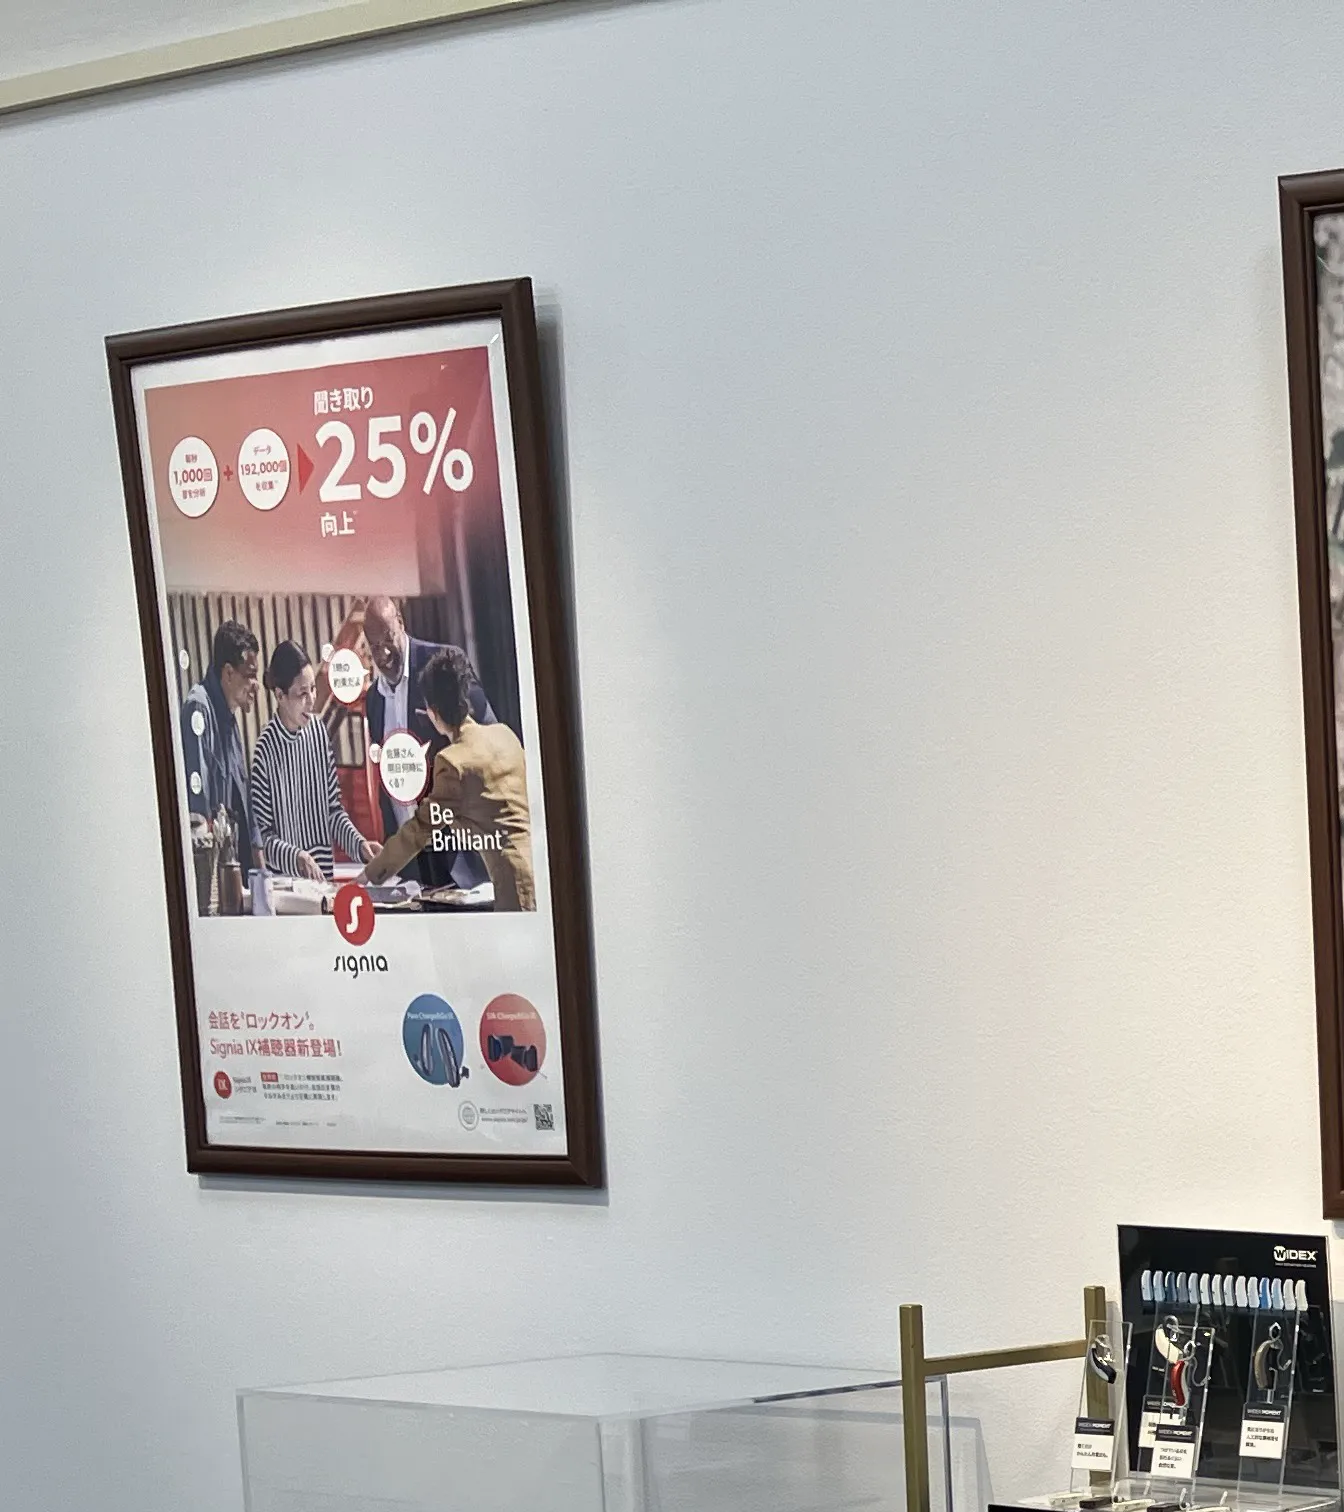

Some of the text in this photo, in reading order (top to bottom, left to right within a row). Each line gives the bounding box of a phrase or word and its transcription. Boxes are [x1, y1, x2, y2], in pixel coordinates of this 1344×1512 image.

[313, 386, 374, 415] 聞き取り
[315, 408, 474, 502] 25%
[173, 468, 213, 485] 1,000回
[430, 803, 454, 826] Be
[333, 954, 390, 979] signia
[209, 1037, 343, 1060] Signia IX補聴器新登場！
[1272, 1244, 1318, 1263] WIDEX
